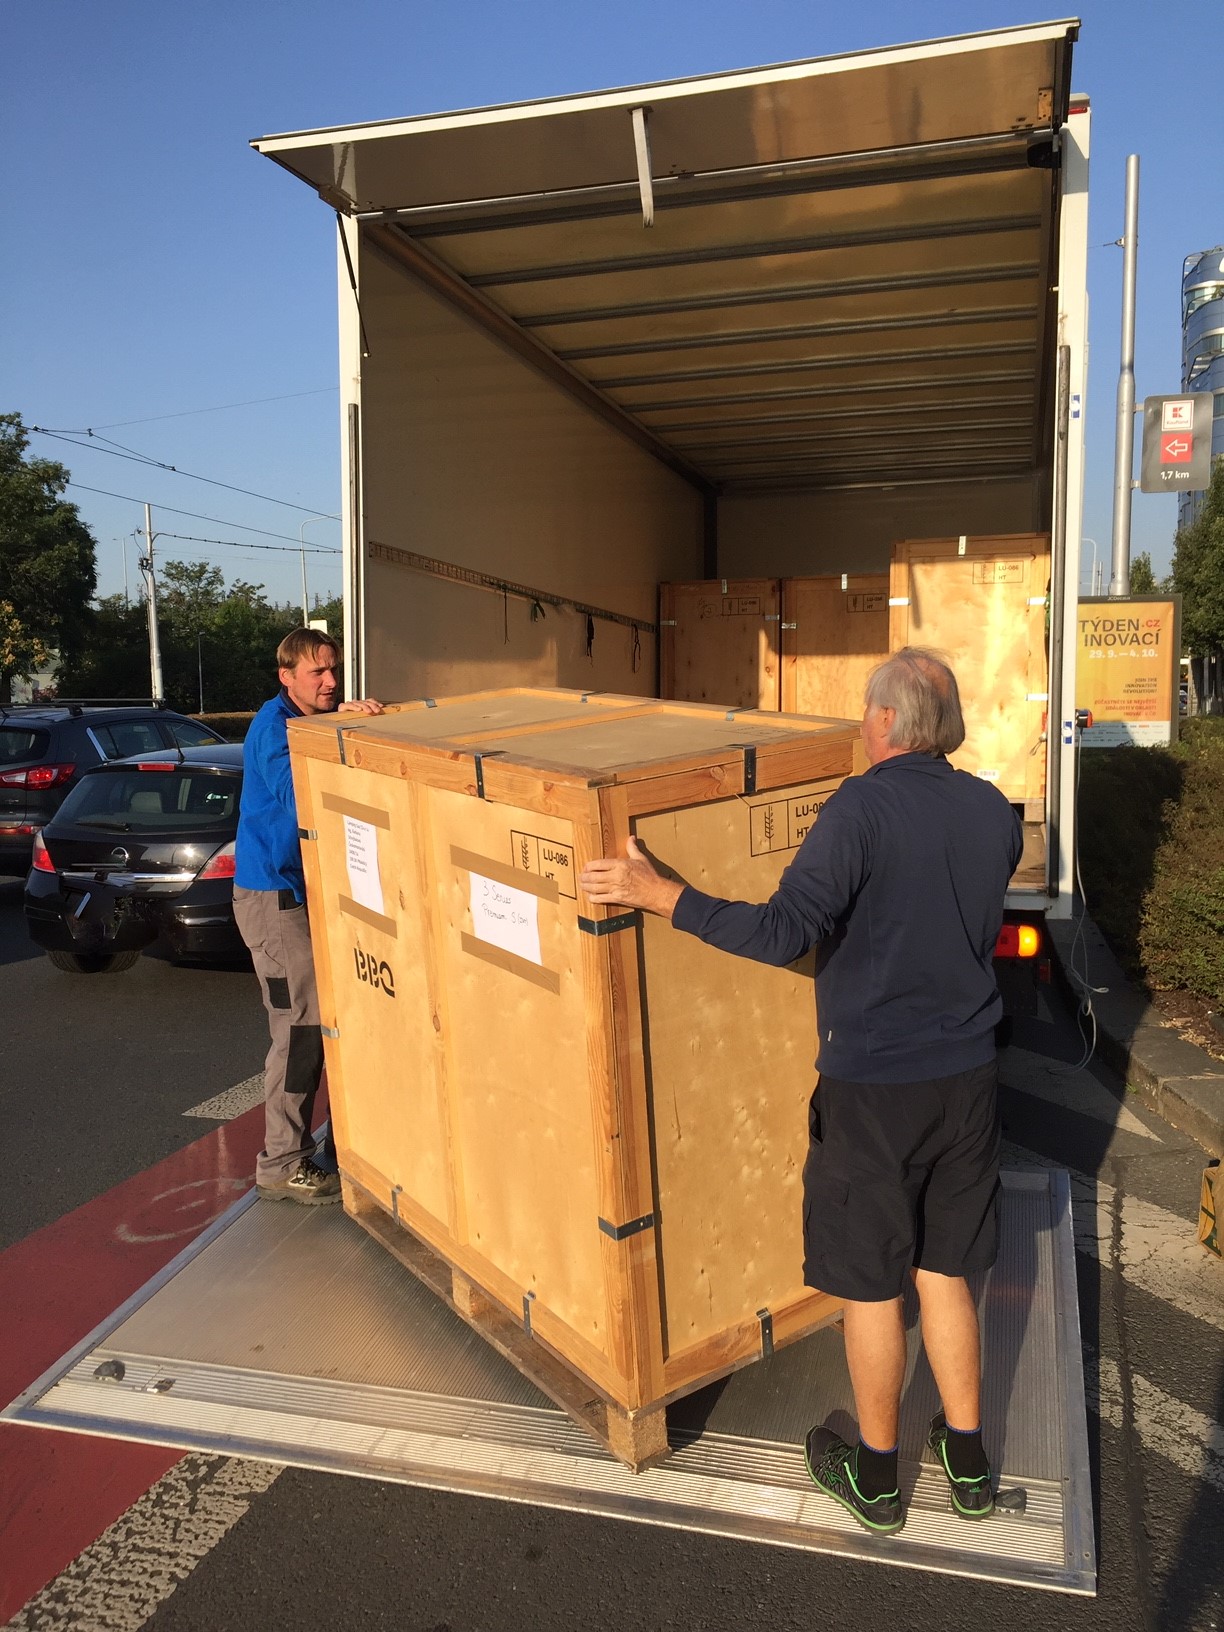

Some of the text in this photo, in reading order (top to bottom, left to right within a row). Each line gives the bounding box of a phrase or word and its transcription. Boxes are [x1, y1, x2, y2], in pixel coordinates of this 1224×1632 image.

[1160, 470, 1190, 480] 1,7 km
[1078, 616, 1140, 632] TÝDEN
[1084, 629, 1162, 647] INOVACÍ
[1141, 648, 1158, 657] 10.
[796, 826, 810, 839] HT
[542, 848, 569, 867] LU-086
[353, 947, 396, 999] BBQ
